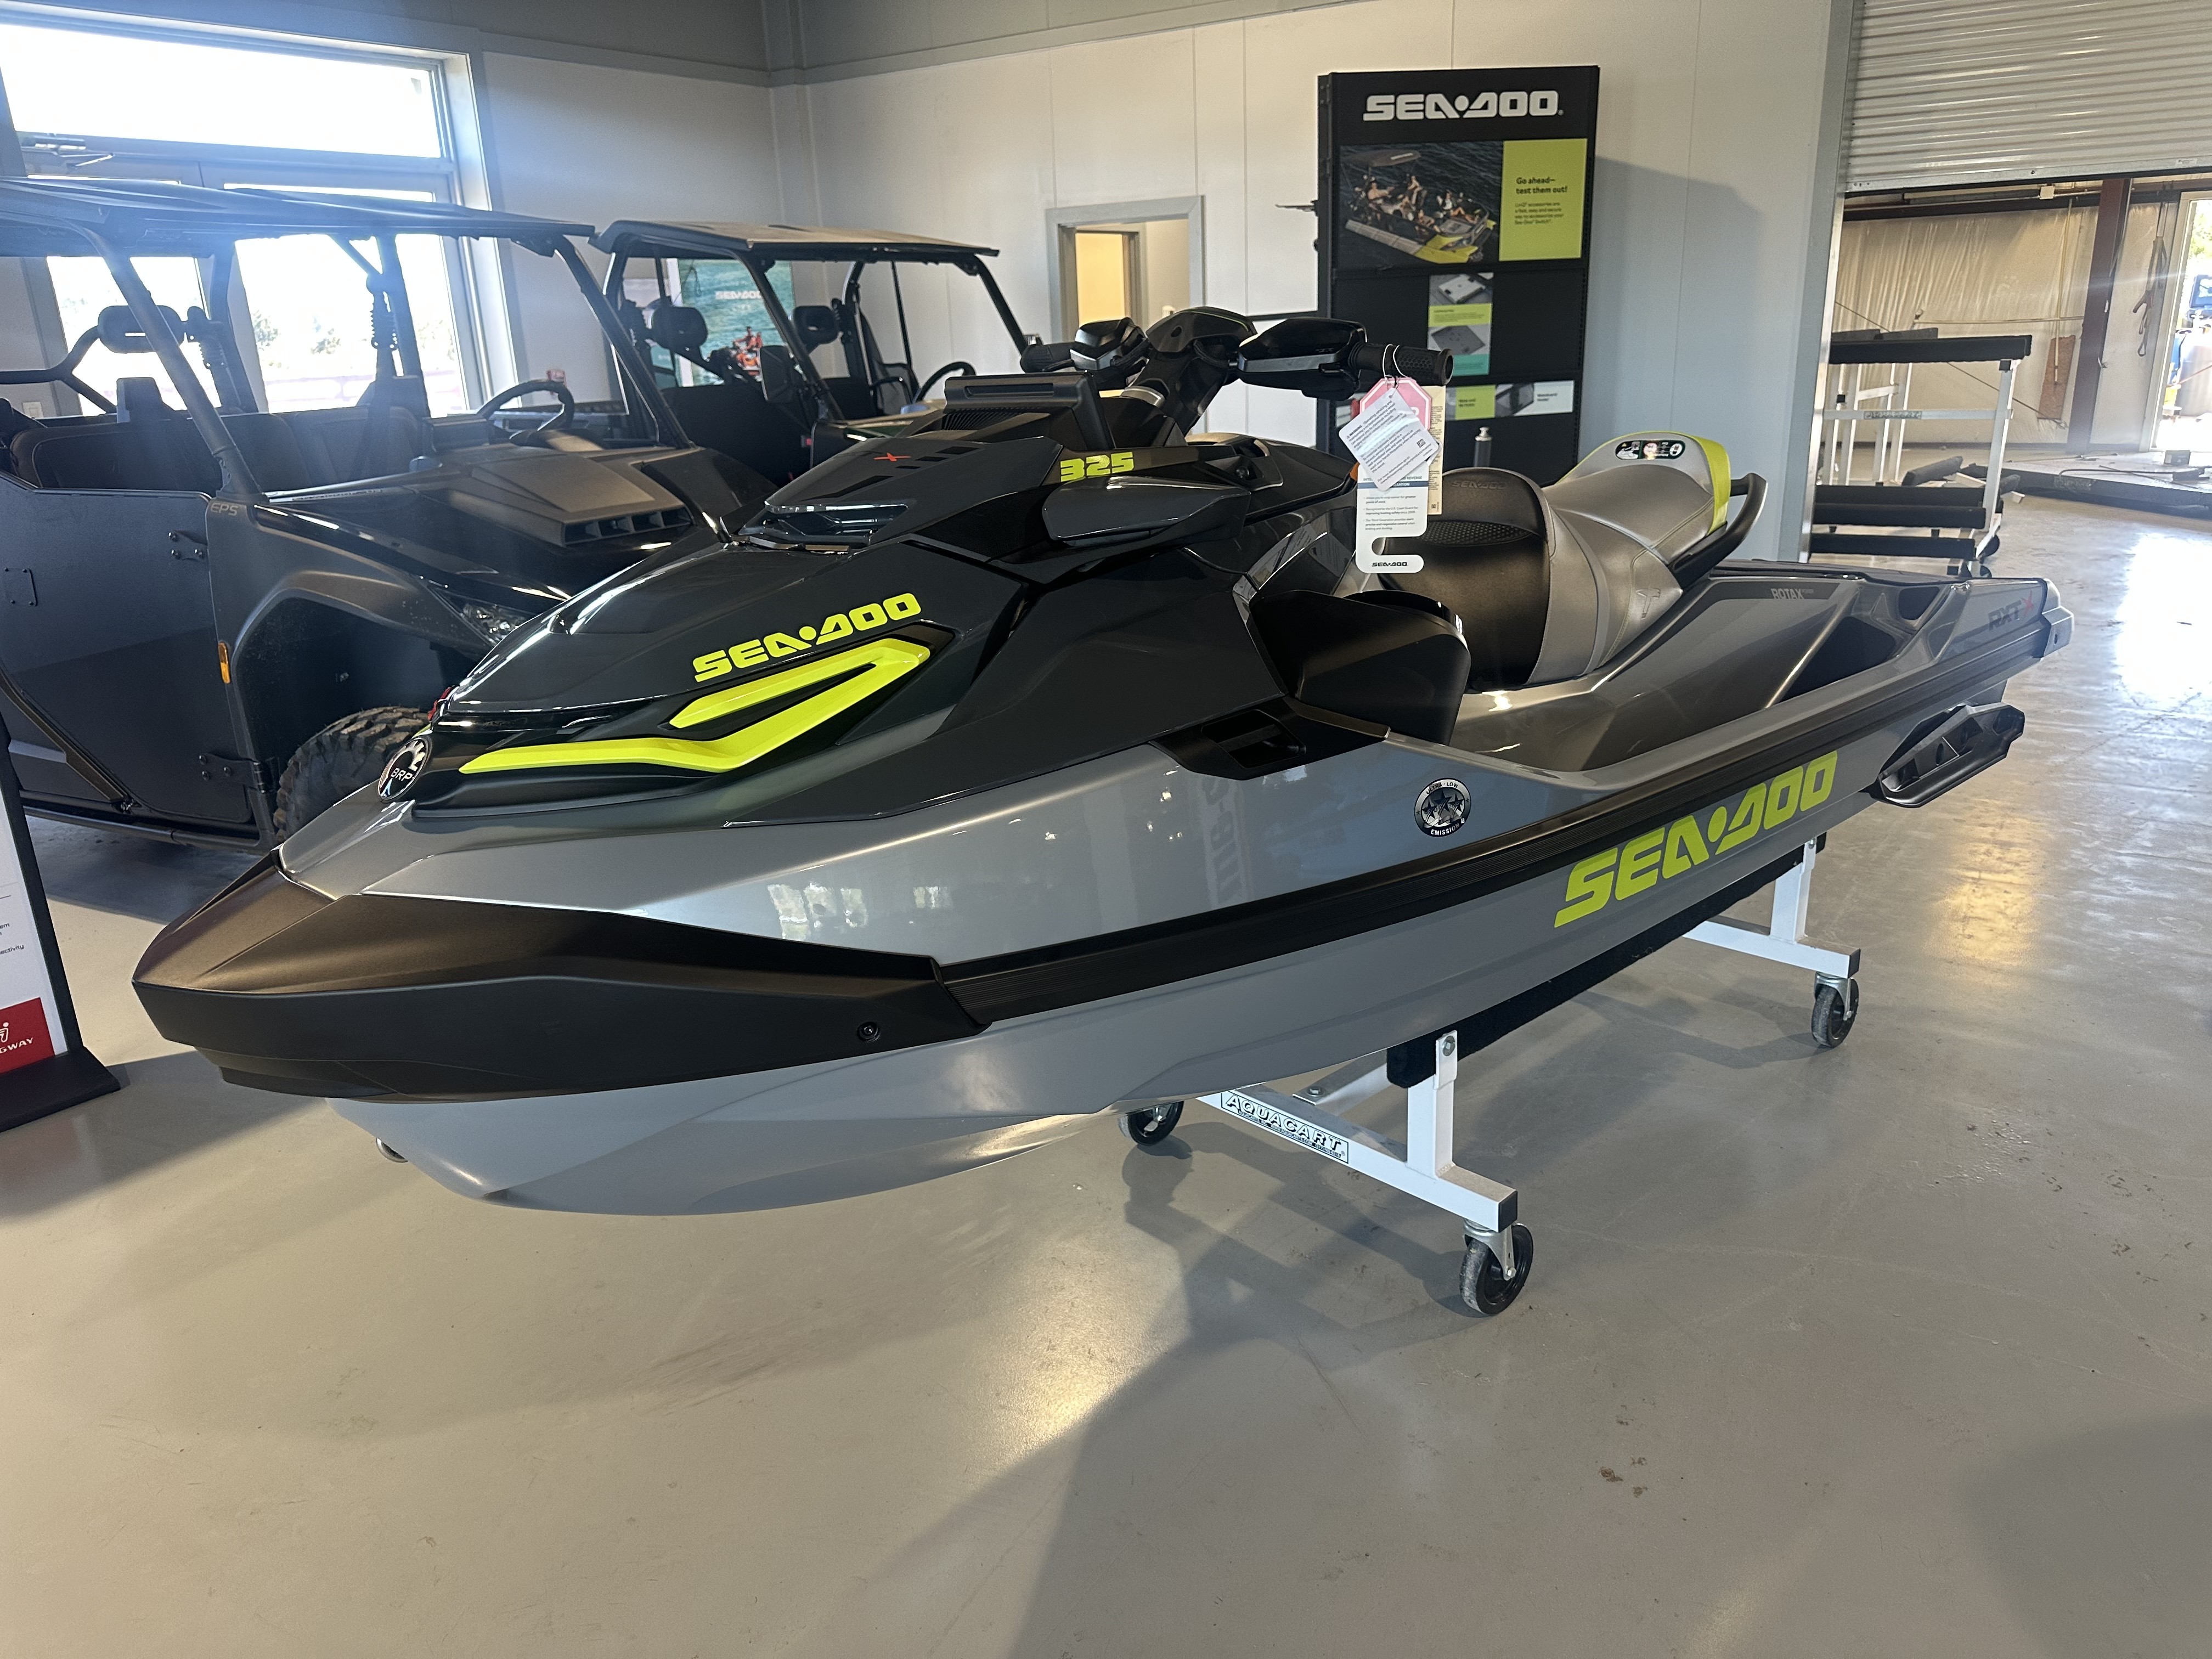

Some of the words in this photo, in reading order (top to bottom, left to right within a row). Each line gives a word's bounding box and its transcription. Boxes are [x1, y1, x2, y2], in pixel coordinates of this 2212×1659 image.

[1533, 186, 1551, 194] them
[1059, 452, 1134, 482] 325
[210, 503, 240, 516] EPS
[1770, 588, 1804, 600] ROTAX
[390, 768, 413, 782] BRP
[1426, 782, 1443, 794] ULTRA
[1430, 823, 1460, 836] EMISSION
[1226, 1094, 1342, 1151] AQUACART
